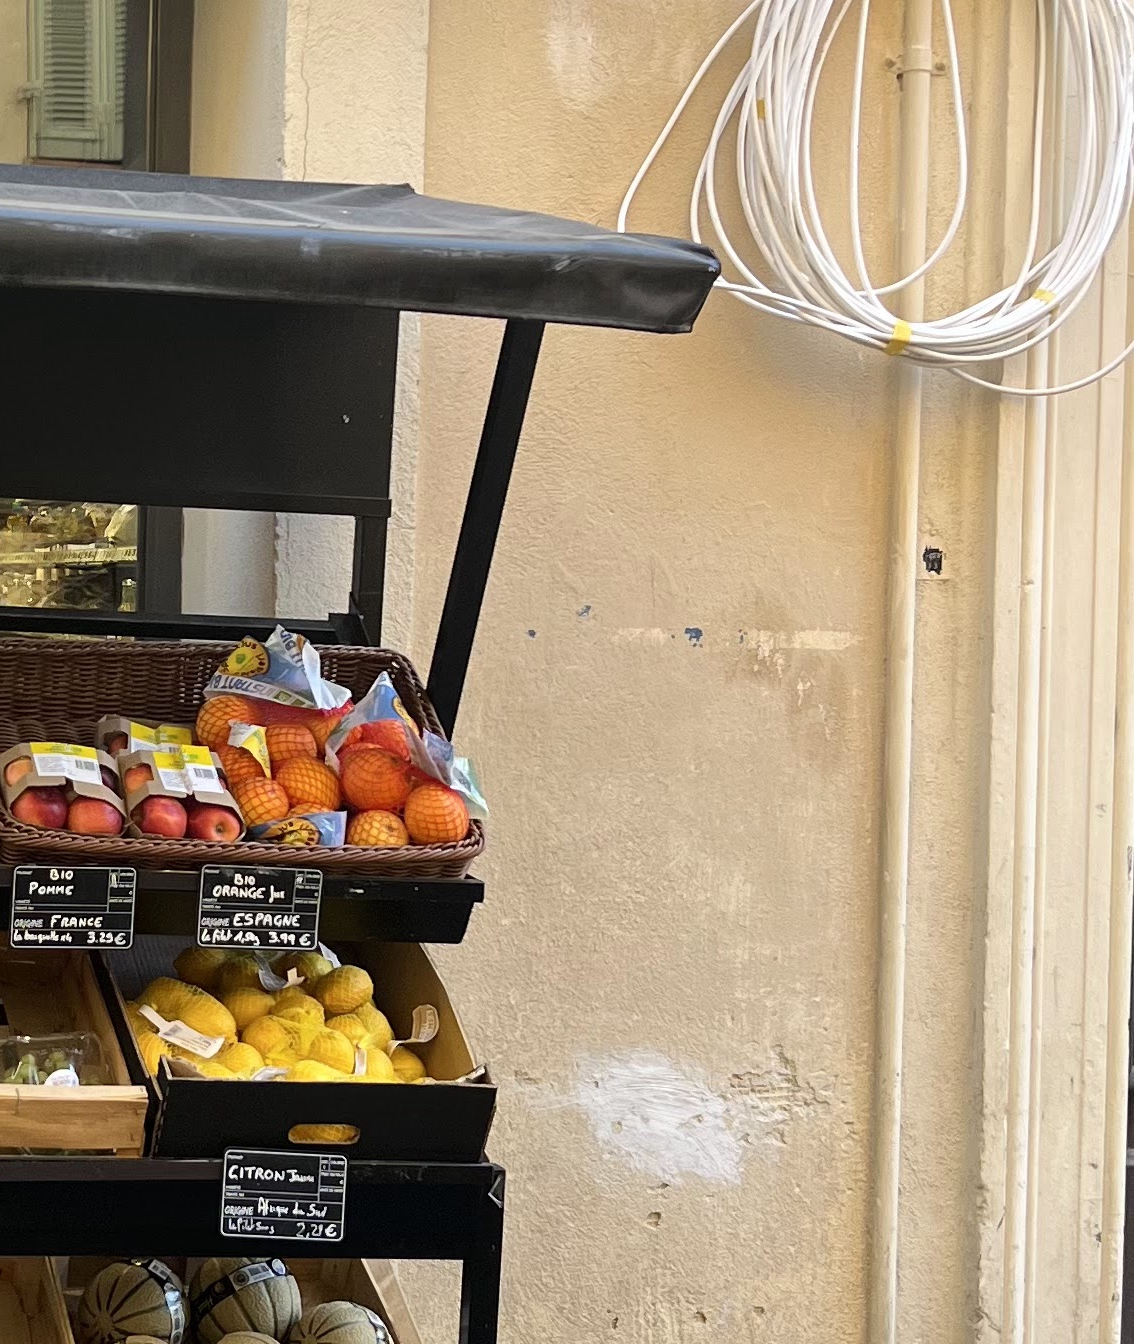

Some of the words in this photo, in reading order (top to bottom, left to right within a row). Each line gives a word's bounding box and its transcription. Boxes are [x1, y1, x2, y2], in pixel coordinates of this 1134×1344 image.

[49, 869, 74, 881] BIO
[234, 873, 256, 885] BIO
[29, 881, 74, 896] POMME
[212, 885, 267, 899] ORANGE
[50, 915, 103, 928] FRANCE
[233, 912, 301, 927] ESPAGNE
[228, 1165, 286, 1182] CITRON
